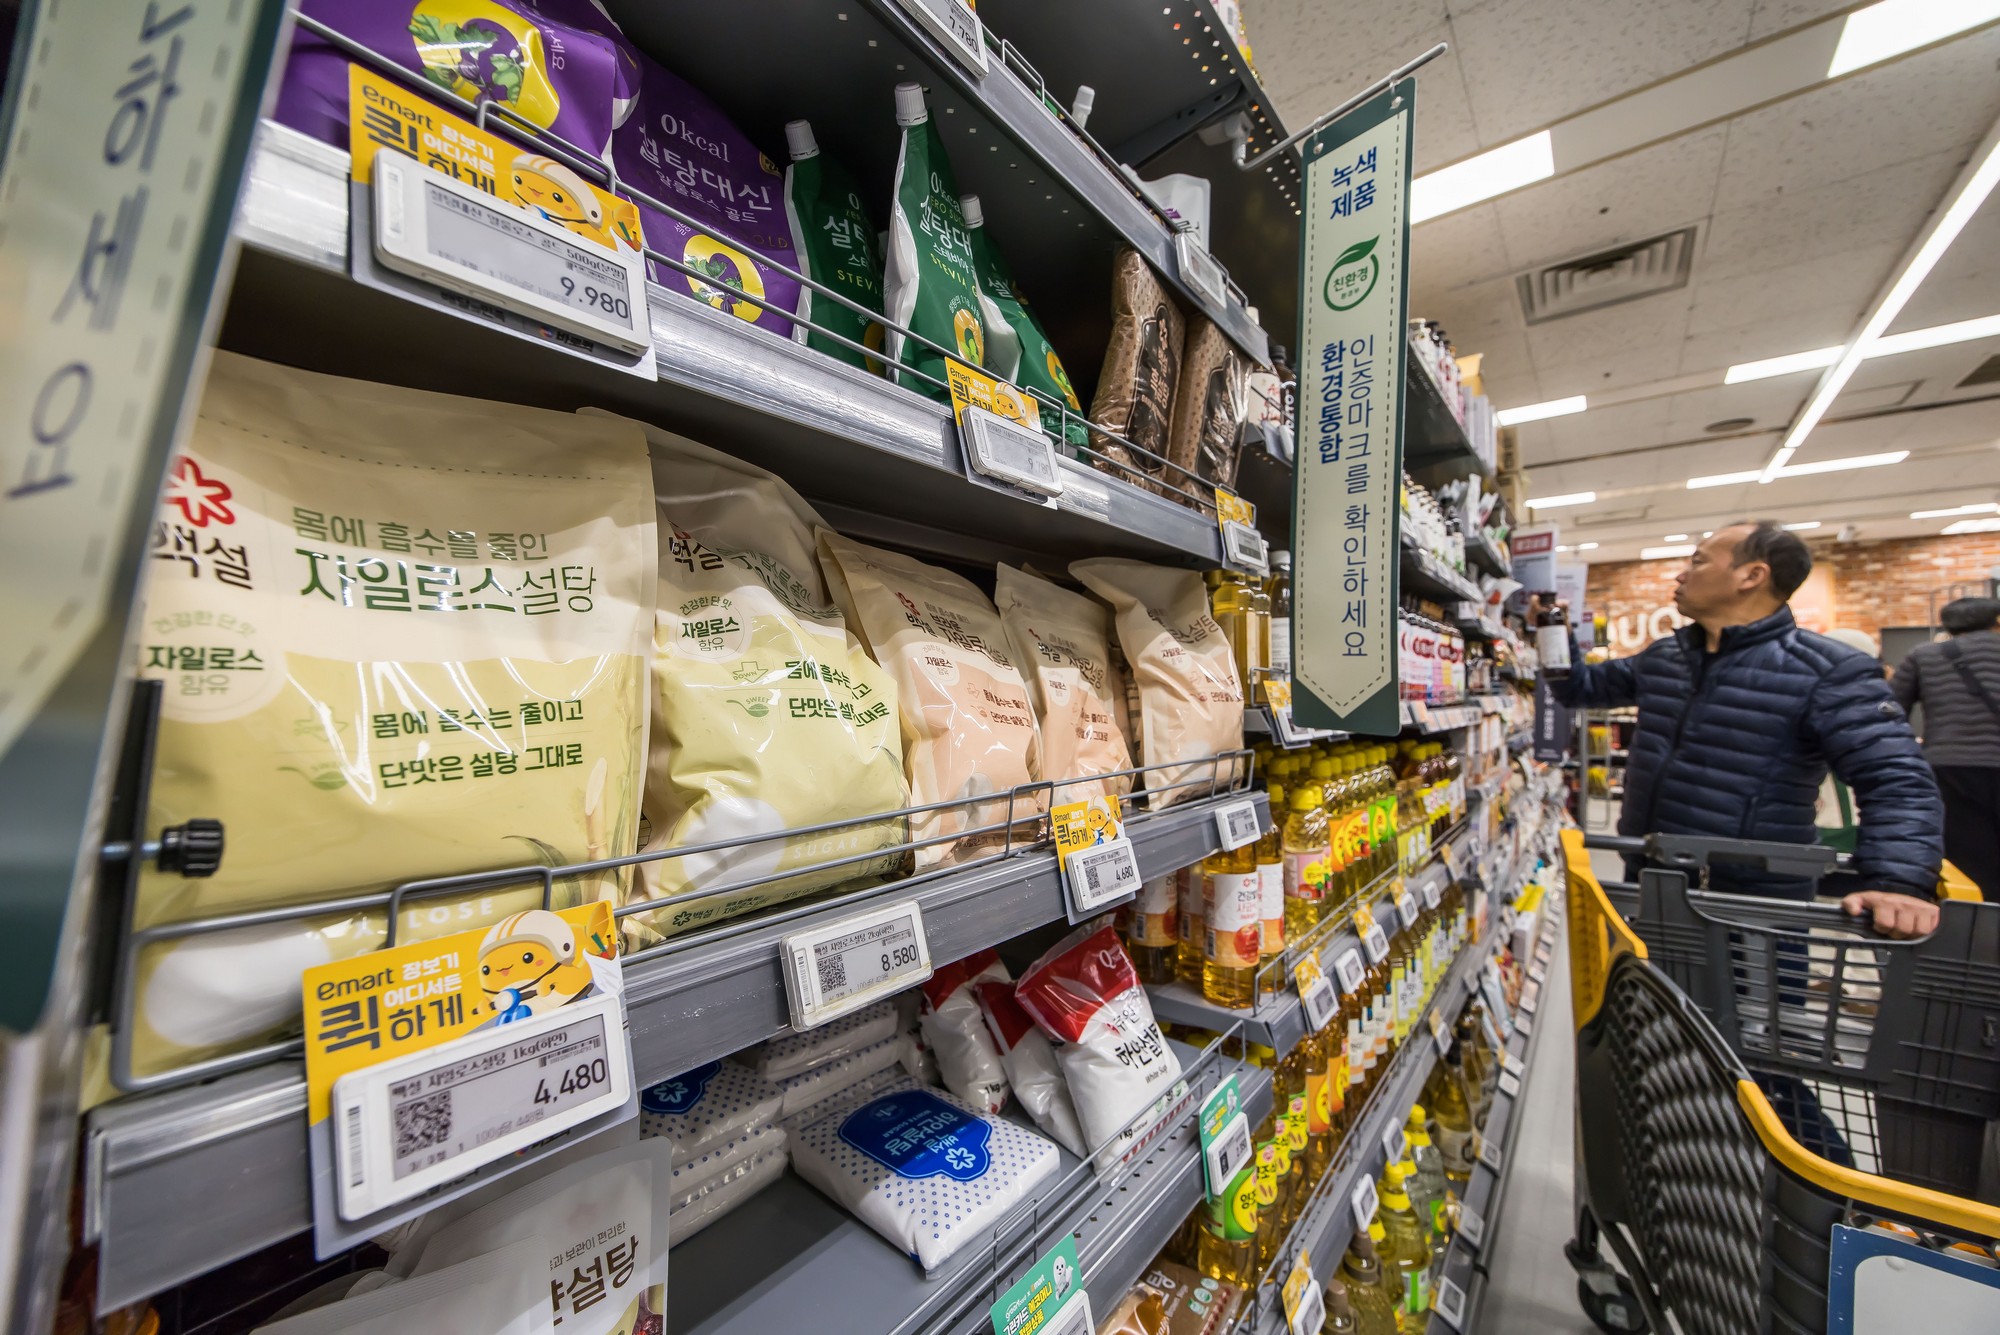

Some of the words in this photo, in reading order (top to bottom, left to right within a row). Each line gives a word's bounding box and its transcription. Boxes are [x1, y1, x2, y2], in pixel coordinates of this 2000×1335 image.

[362, 84, 434, 132] emart
[441, 123, 494, 161] 장보기
[661, 113, 731, 163] 0kcal
[423, 132, 496, 179] 어디서든
[639, 123, 773, 211] 설탕대신
[1330, 146, 1377, 188] 녹색
[1330, 180, 1377, 219] 제품
[752, 232, 789, 250] OLD
[920, 194, 973, 260] 설탕대
[1332, 266, 1368, 293] 친환경
[949, 367, 971, 385] emart
[1318, 340, 1346, 464] 환경통합
[1344, 334, 1374, 495] 인증마크를
[292, 506, 367, 548] 몸에
[378, 521, 479, 560] 흡수를
[487, 531, 549, 562] 줄인
[151, 520, 253, 590] 백설
[294, 547, 598, 617] 자일로스설탕
[1341, 504, 1370, 657] 확인하세요
[679, 596, 711, 616] 건강한
[710, 595, 732, 611] 단맛
[681, 616, 740, 639] 자일로스
[698, 637, 724, 652] 함유
[145, 646, 264, 672] 자일로스
[732, 670, 758, 681] DOWN
[785, 660, 817, 681] 몸에
[924, 656, 953, 669] 자일로스
[180, 676, 229, 695] 함유
[372, 709, 429, 740] 몸에
[437, 706, 512, 734] 흡수는
[518, 698, 585, 725] 줄이고
[789, 697, 836, 718] 단맛은
[379, 755, 466, 790] 단맛은
[469, 748, 521, 779] 설탕
[525, 741, 584, 771] 그대로
[1054, 813, 1070, 822] emart
[1057, 823, 1072, 847] 퀵
[1070, 829, 1089, 845] 하게
[793, 836, 859, 860] SUGAR
[693, 908, 714, 920] 백설
[815, 946, 829, 956] 백설
[830, 932, 866, 951] 자일로스설탕
[881, 944, 917, 972] 8,580
[317, 968, 395, 1001] emart
[402, 952, 459, 982] 장보기
[384, 975, 462, 1008] 어디서든
[318, 996, 380, 1054] 퀵
[388, 994, 464, 1042] 하게
[533, 1058, 606, 1105] 4,480
[884, 1111, 959, 1156] 하얀설탕
[923, 1134, 959, 1154] 백설
[565, 1236, 595, 1263] 보관이
[597, 1220, 627, 1245] 편리한
[1003, 1306, 1029, 1335] 그린카드
[1028, 1280, 1053, 1314] 에코머니
